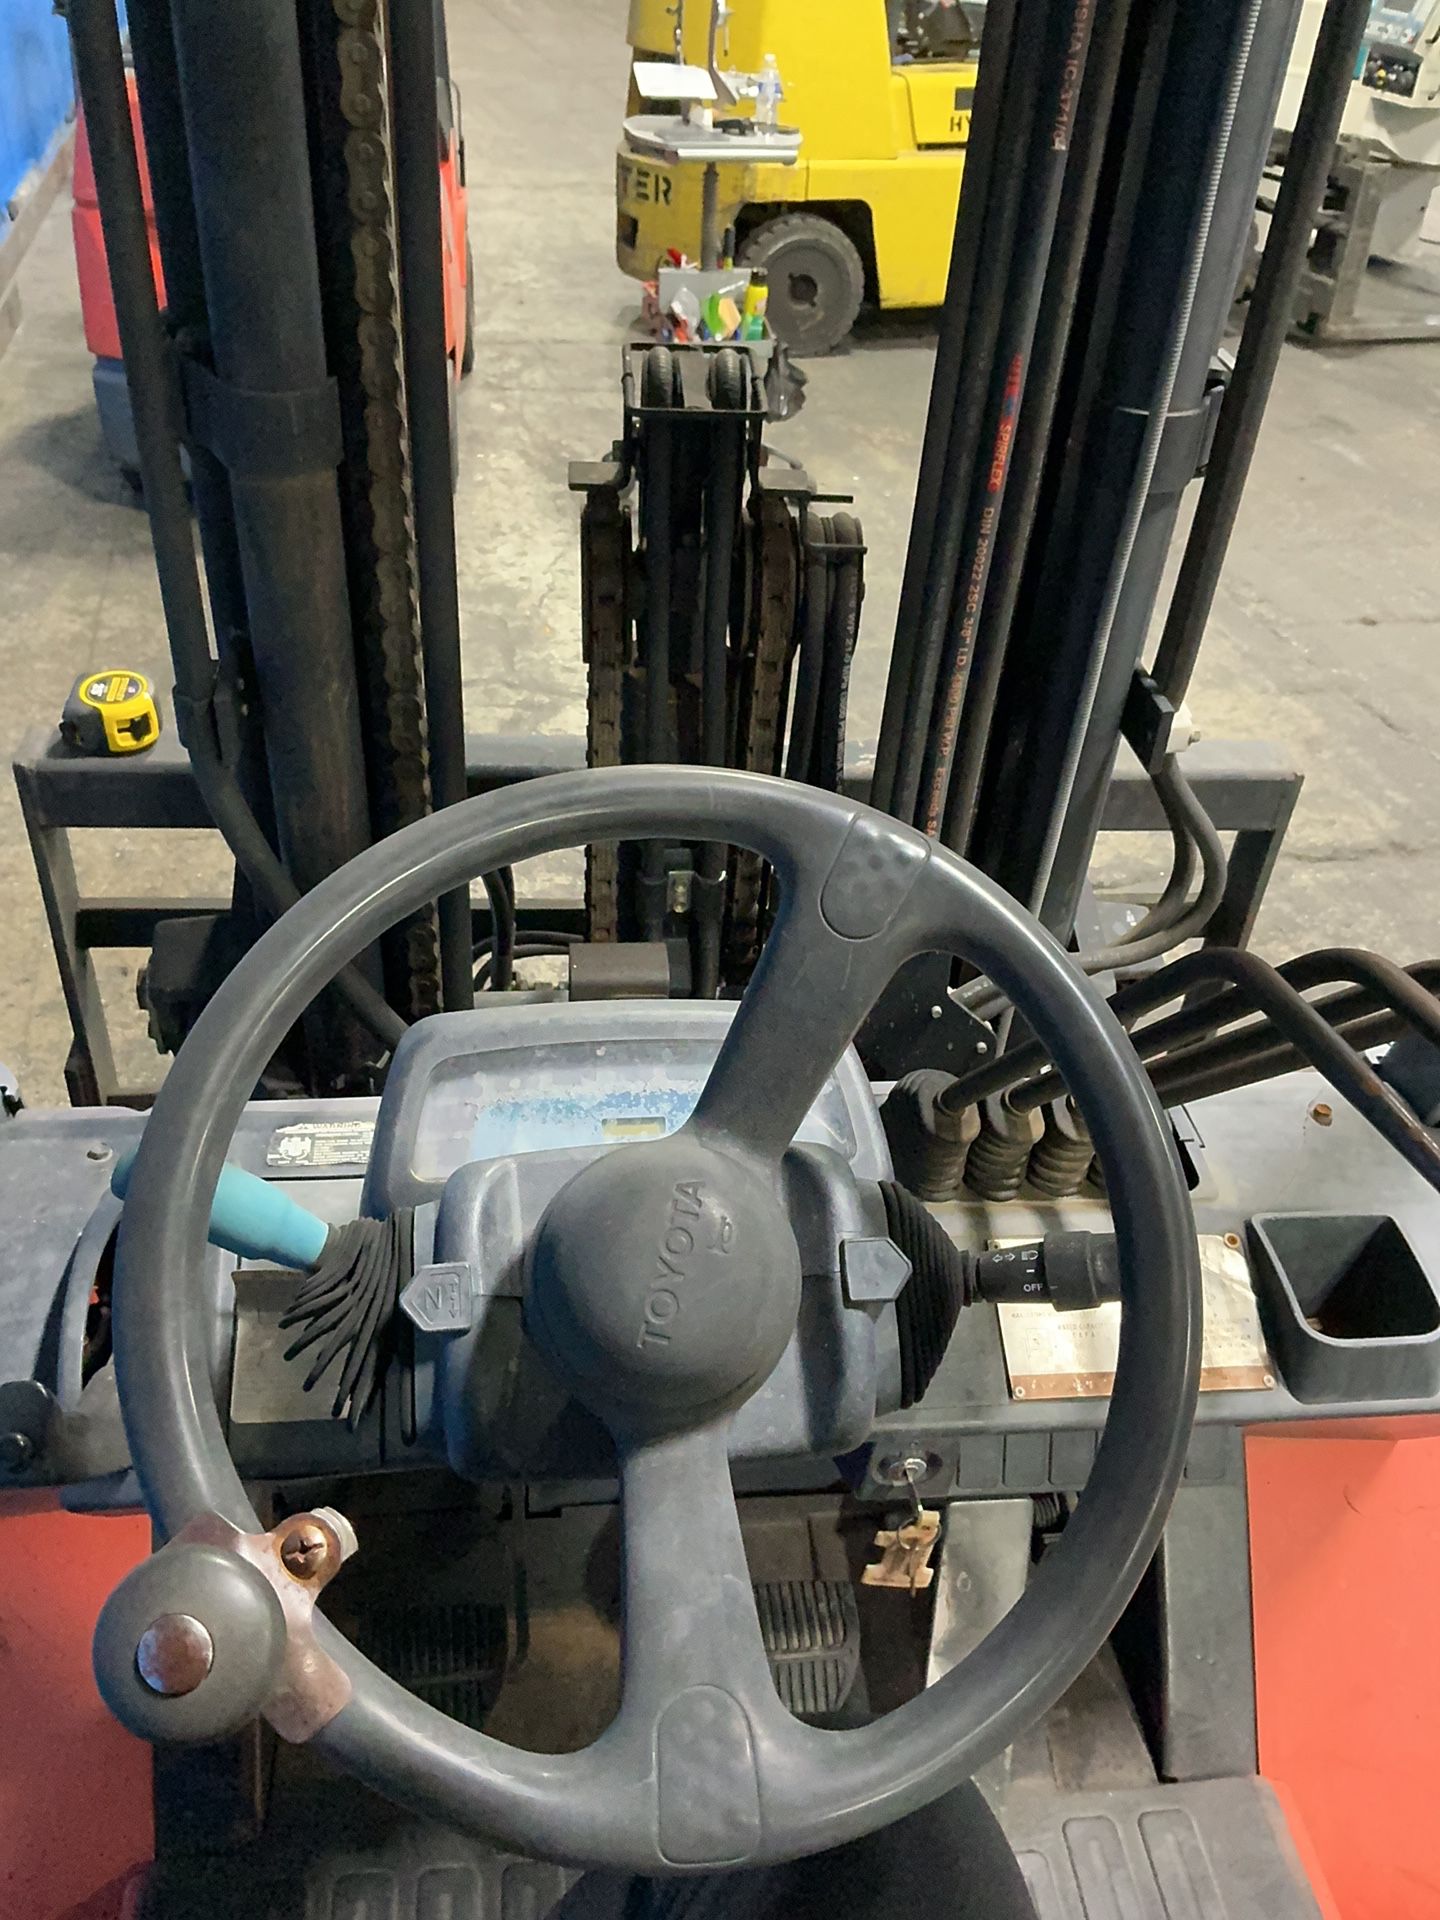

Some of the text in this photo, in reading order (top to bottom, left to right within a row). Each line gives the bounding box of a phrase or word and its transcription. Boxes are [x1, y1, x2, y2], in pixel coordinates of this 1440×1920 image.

[988, 424, 1012, 490] SPIRFLEX
[978, 506, 995, 534] DIN
[970, 539, 990, 582] 20022
[965, 584, 980, 613] 2SC
[636, 1179, 706, 1350] TOYOTA
[1023, 1283, 1044, 1293] OFF
